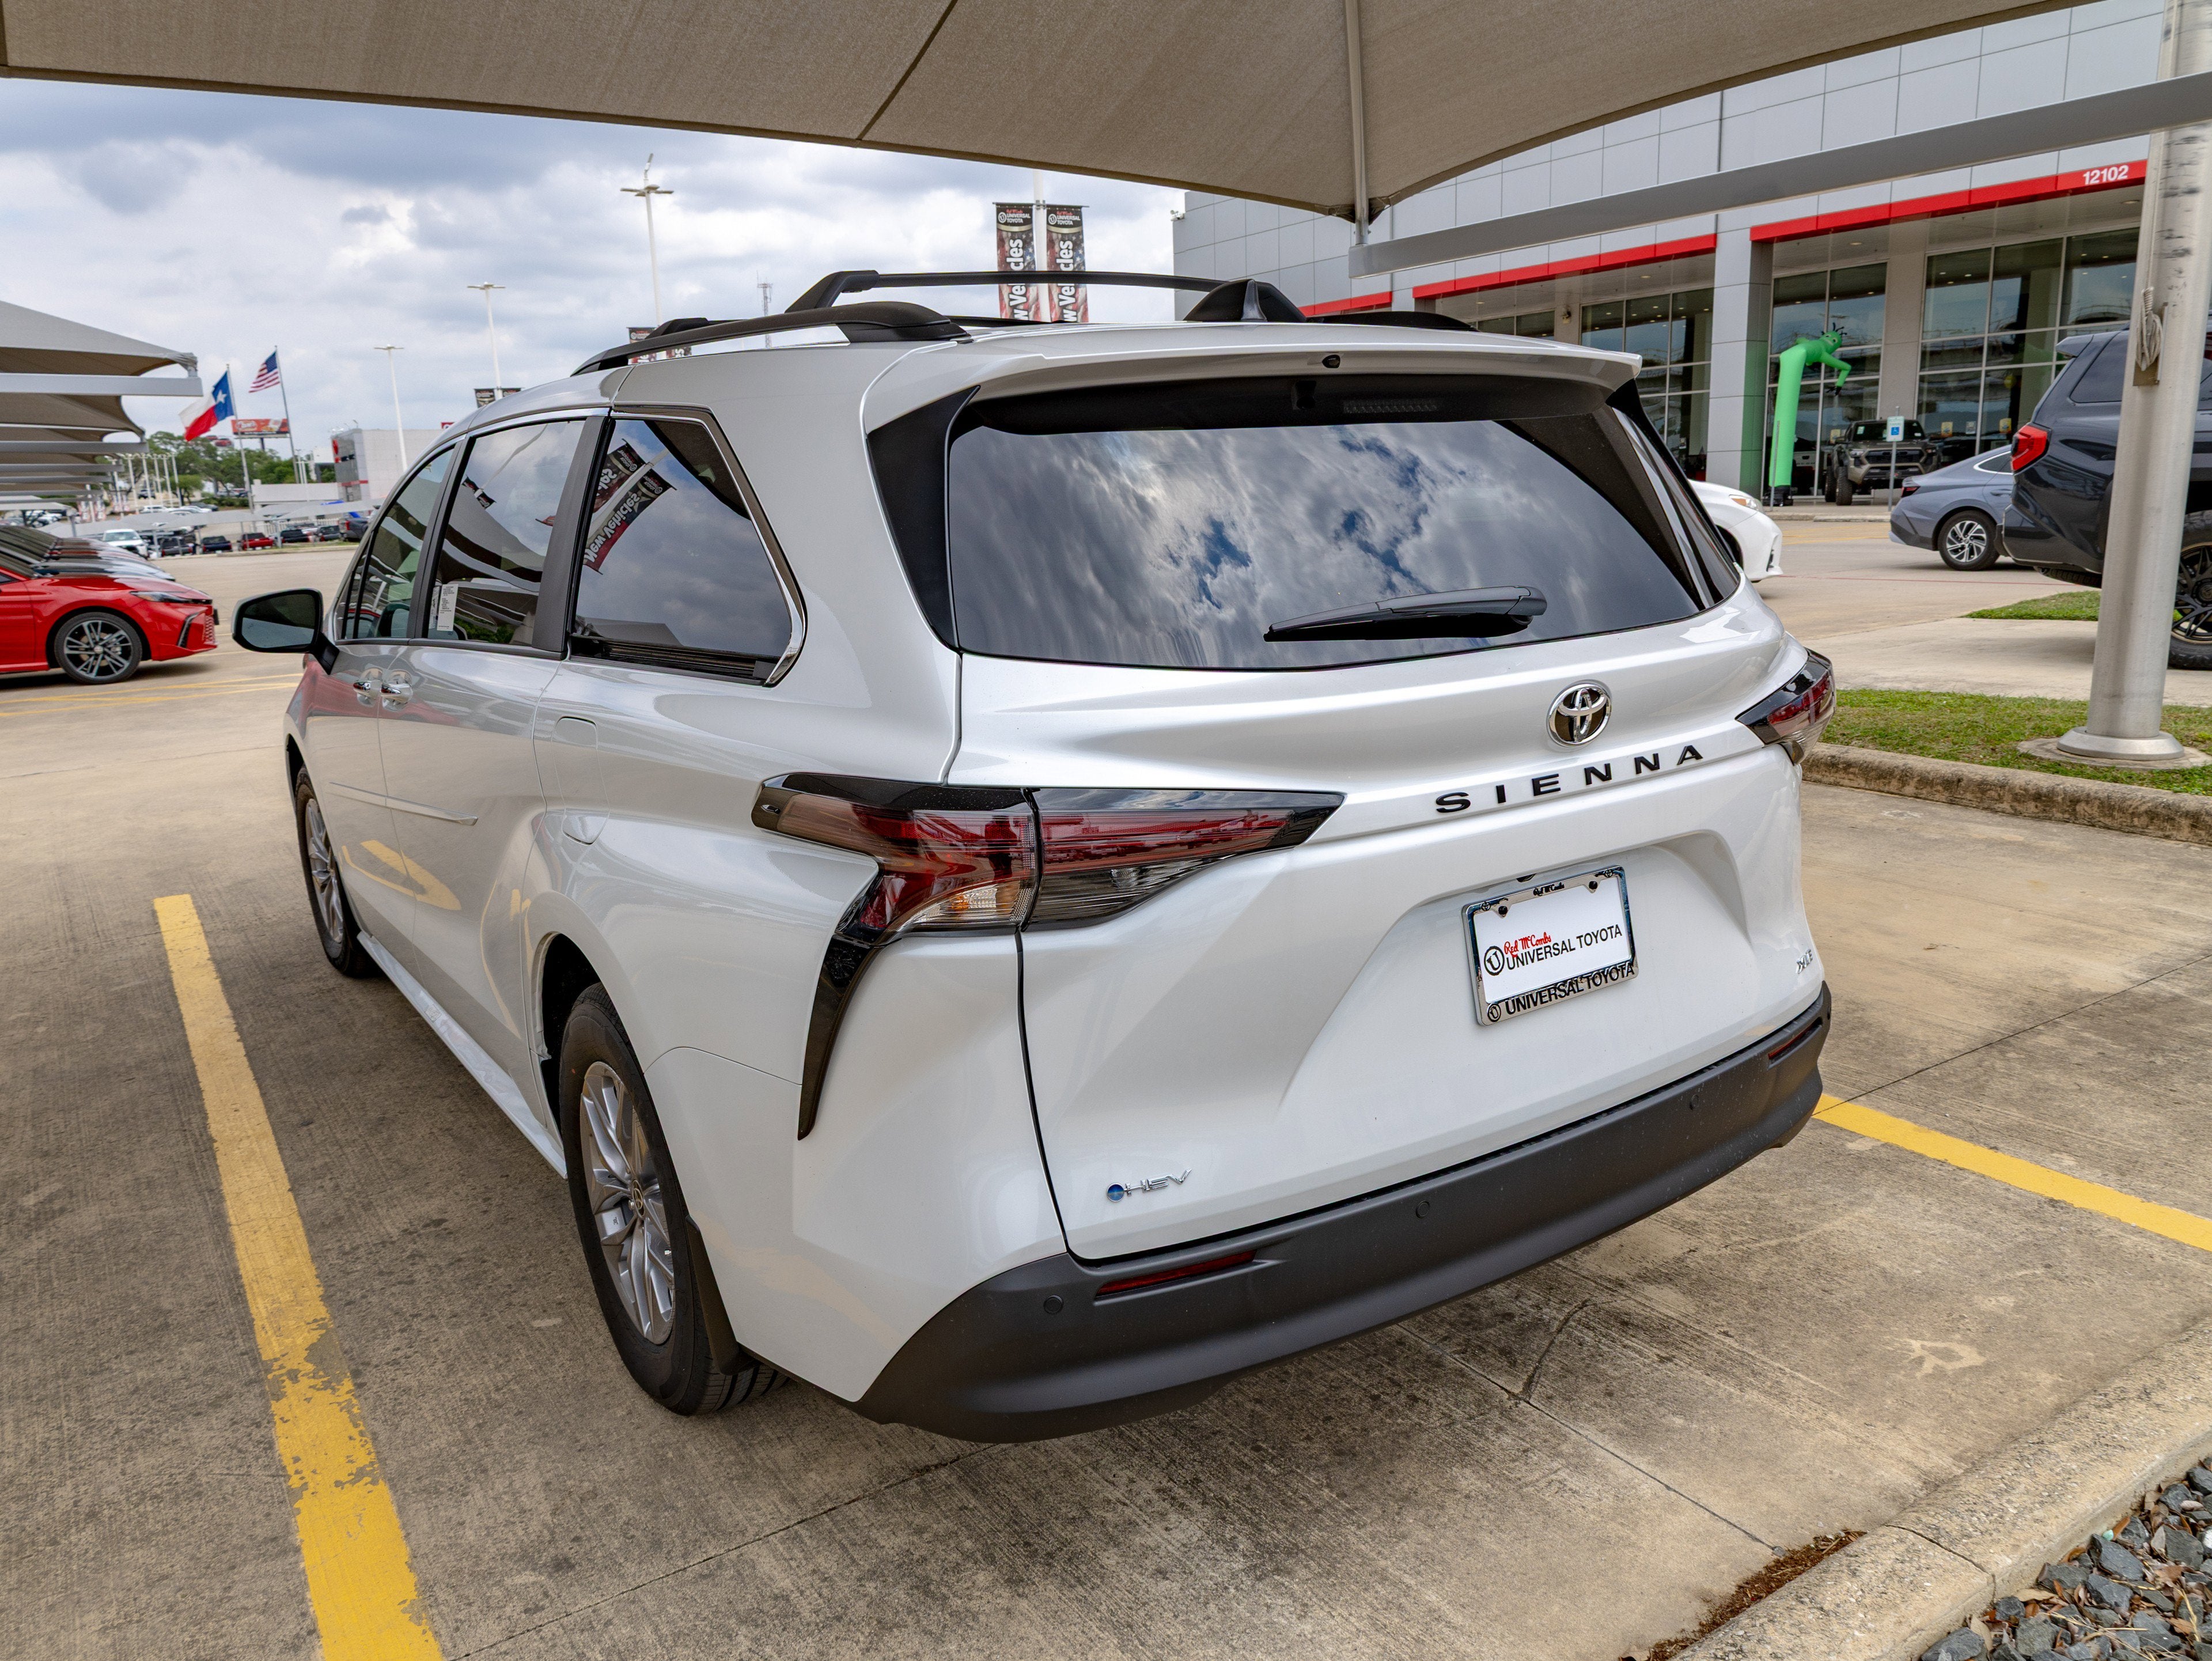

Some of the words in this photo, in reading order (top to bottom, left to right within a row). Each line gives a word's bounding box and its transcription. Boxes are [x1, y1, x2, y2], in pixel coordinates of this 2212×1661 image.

[2083, 165, 2129, 185] 12102
[1006, 239, 1027, 306] Vecles
[1056, 241, 1076, 307] Vecles
[1435, 745, 1703, 813] SIENNA
[1504, 940, 1519, 958] Red
[1518, 932, 1552, 950] McCombs
[1506, 939, 1576, 970] UNIVERSAL
[1576, 924, 1623, 948] TOYOTA
[1795, 948, 1813, 974] XLE
[1505, 979, 1584, 1015] UNIVERSAL
[1583, 962, 1635, 990] TOYOTA
[1124, 1168, 1193, 1197] HEV
